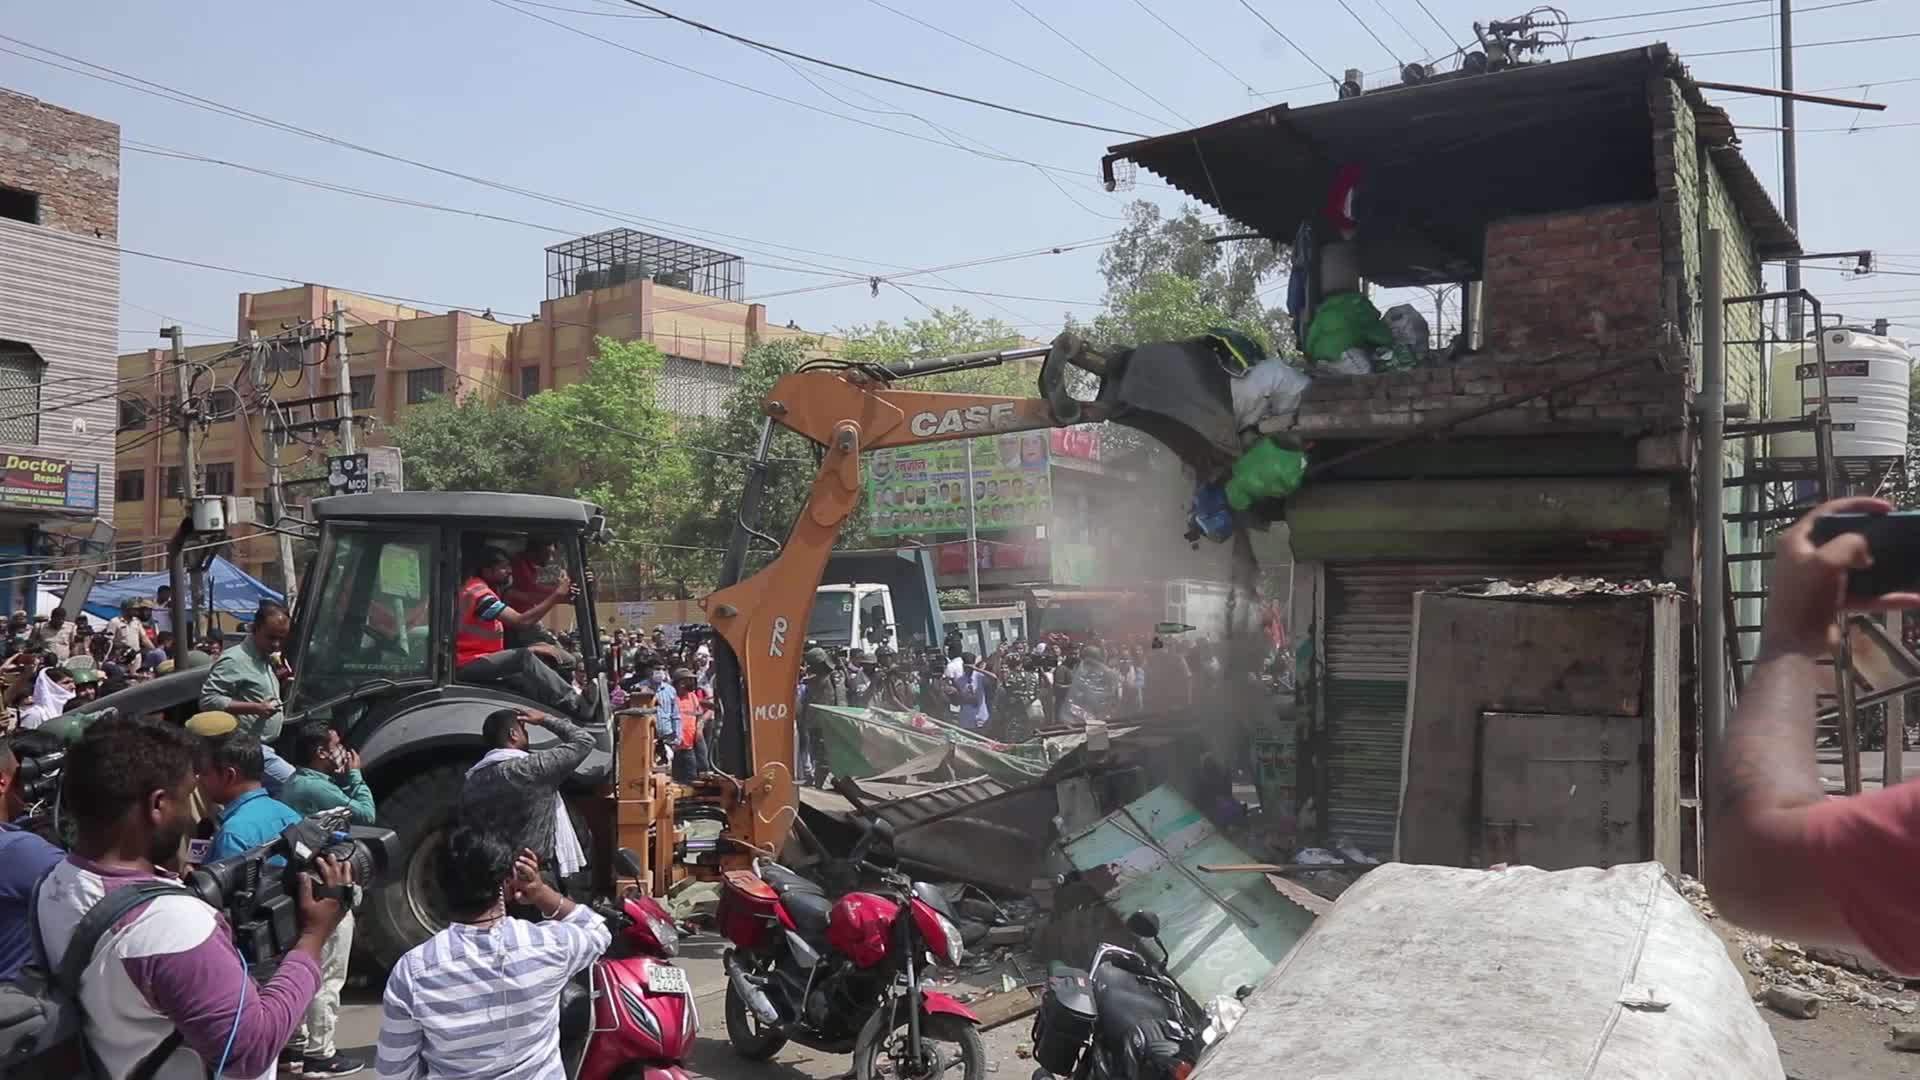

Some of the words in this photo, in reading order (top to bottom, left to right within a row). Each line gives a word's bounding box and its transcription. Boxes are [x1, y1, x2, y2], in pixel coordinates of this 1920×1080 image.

[911, 402, 1015, 437] CASE
[6, 455, 66, 473] Doctor
[33, 473, 64, 484] Repair
[348, 479, 367, 490] MCD
